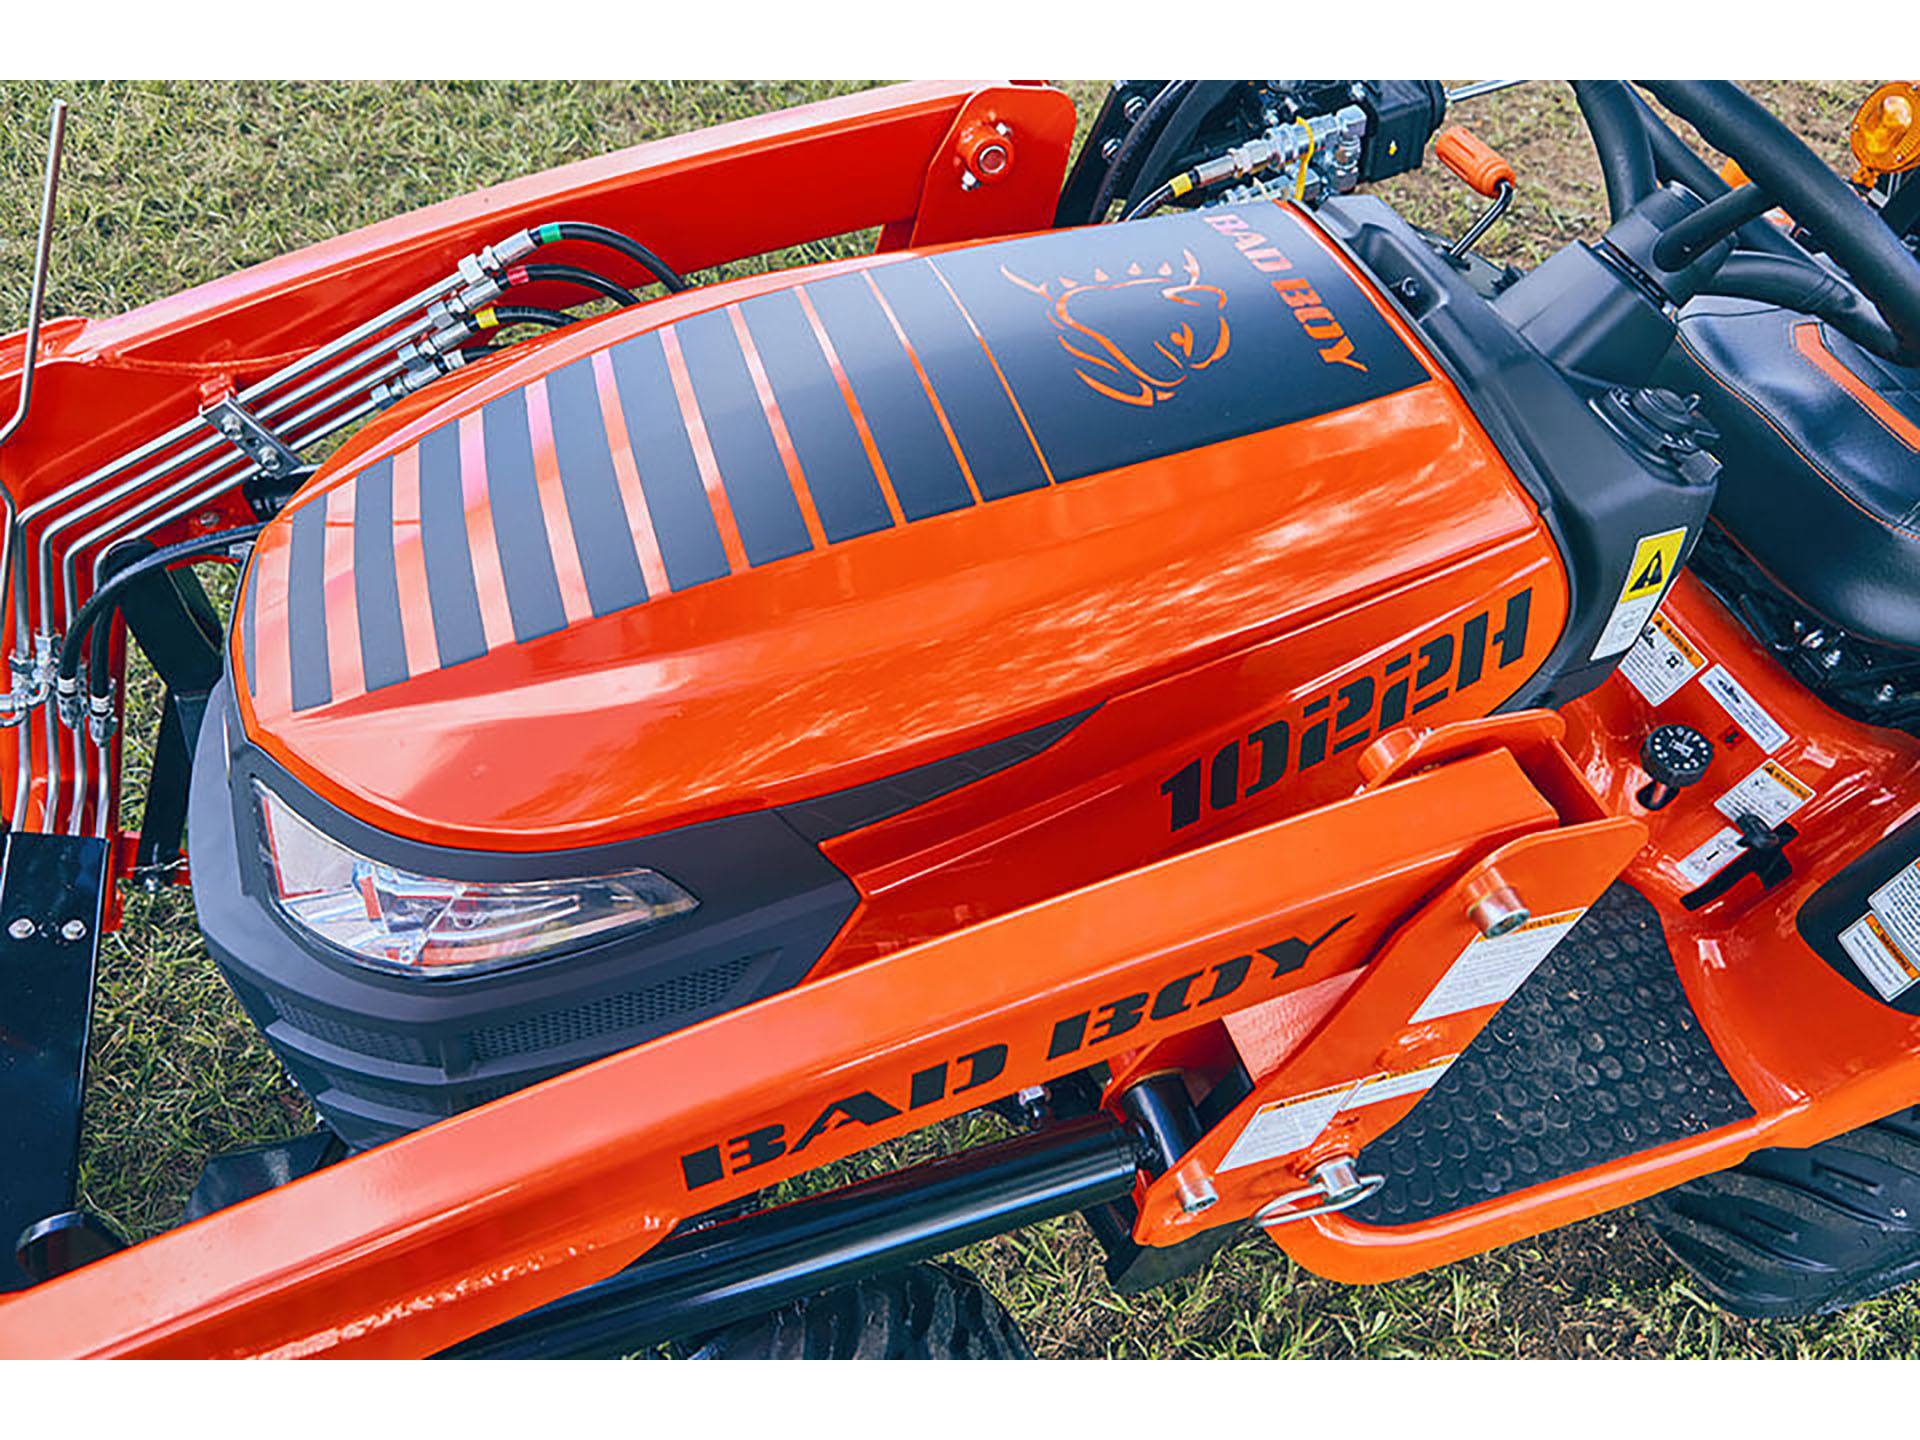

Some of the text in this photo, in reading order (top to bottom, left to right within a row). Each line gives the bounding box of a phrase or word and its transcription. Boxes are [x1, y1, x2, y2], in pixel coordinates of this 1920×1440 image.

[1202, 213, 1369, 373] BAD BOY
[1160, 587, 1532, 833] 1022H
[679, 1043, 1009, 1191] BAD
[1046, 914, 1355, 1060] BOY
